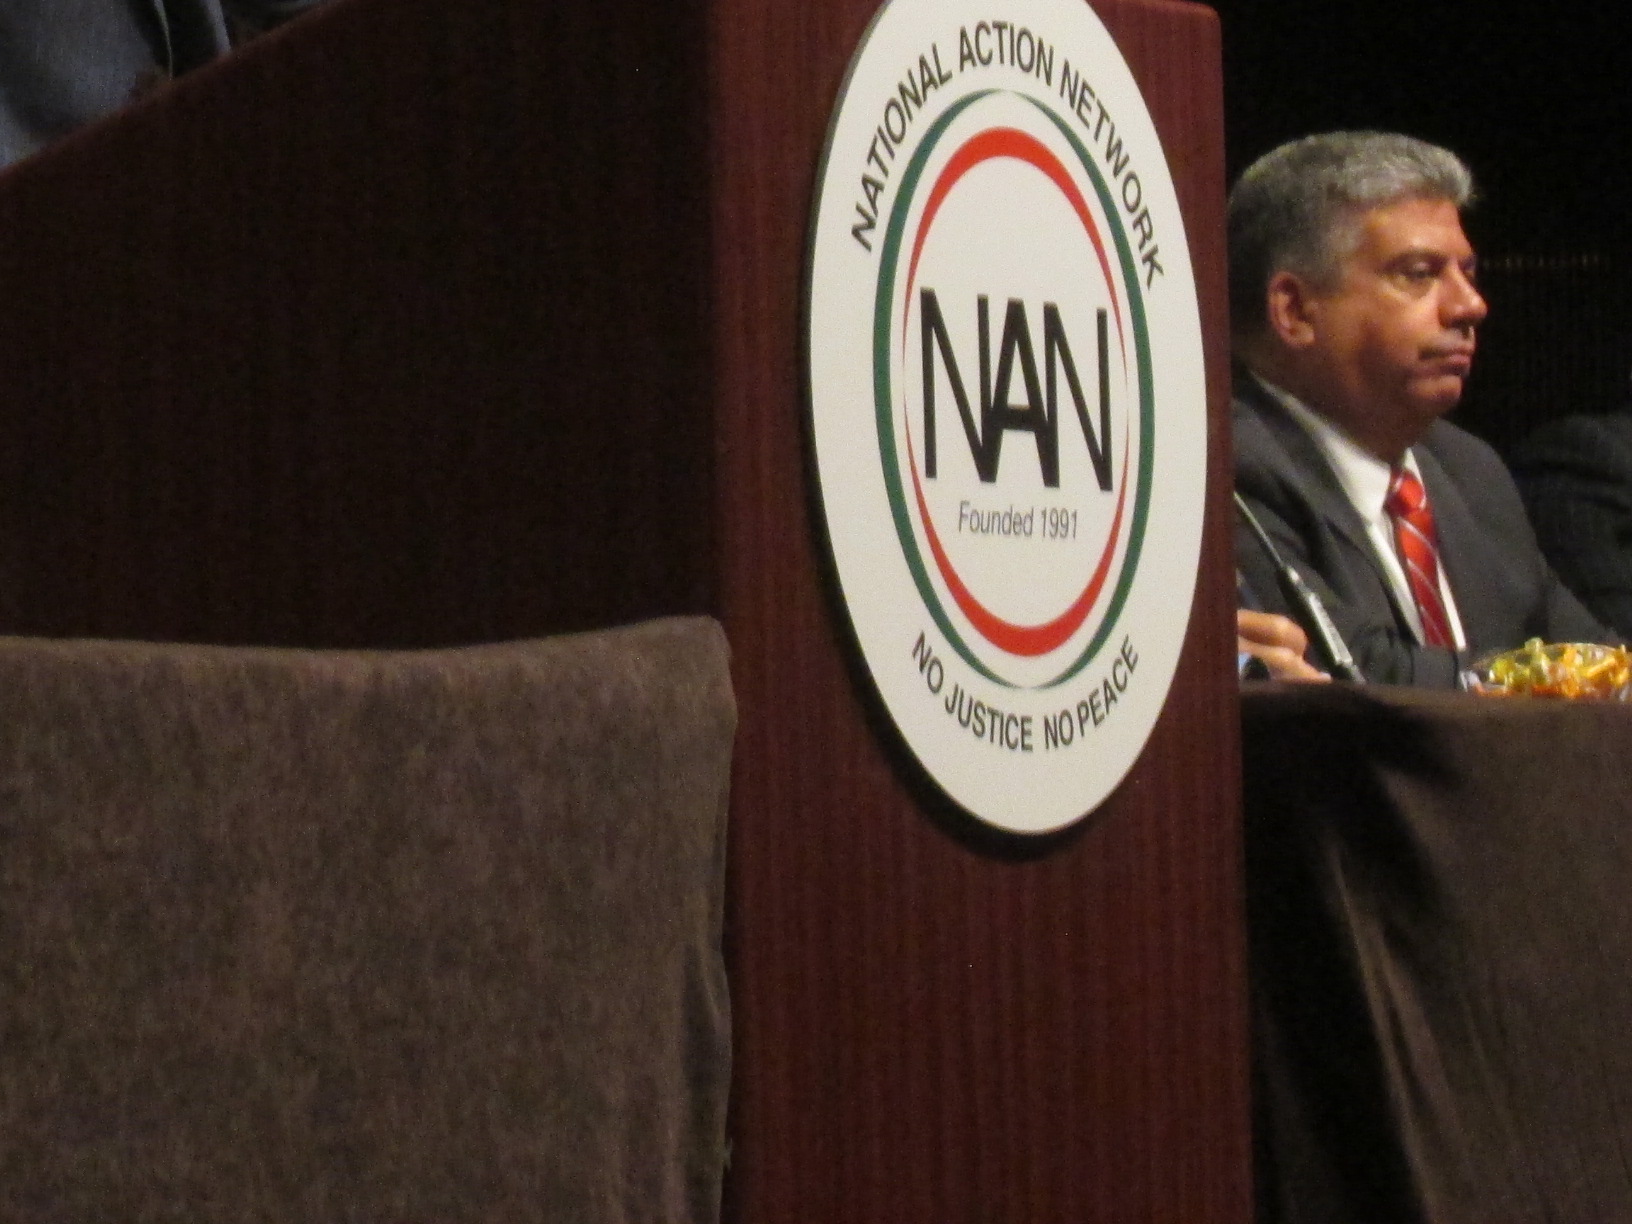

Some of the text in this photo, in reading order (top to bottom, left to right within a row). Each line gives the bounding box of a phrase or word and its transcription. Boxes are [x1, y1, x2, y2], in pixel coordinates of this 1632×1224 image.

[850, 20, 1165, 291] NATIONAL ACTION NETWORK
[920, 286, 1114, 493] NAN
[957, 501, 1080, 541] Founded 1991
[912, 629, 1140, 752] NO JUSTICE NO PEACE
